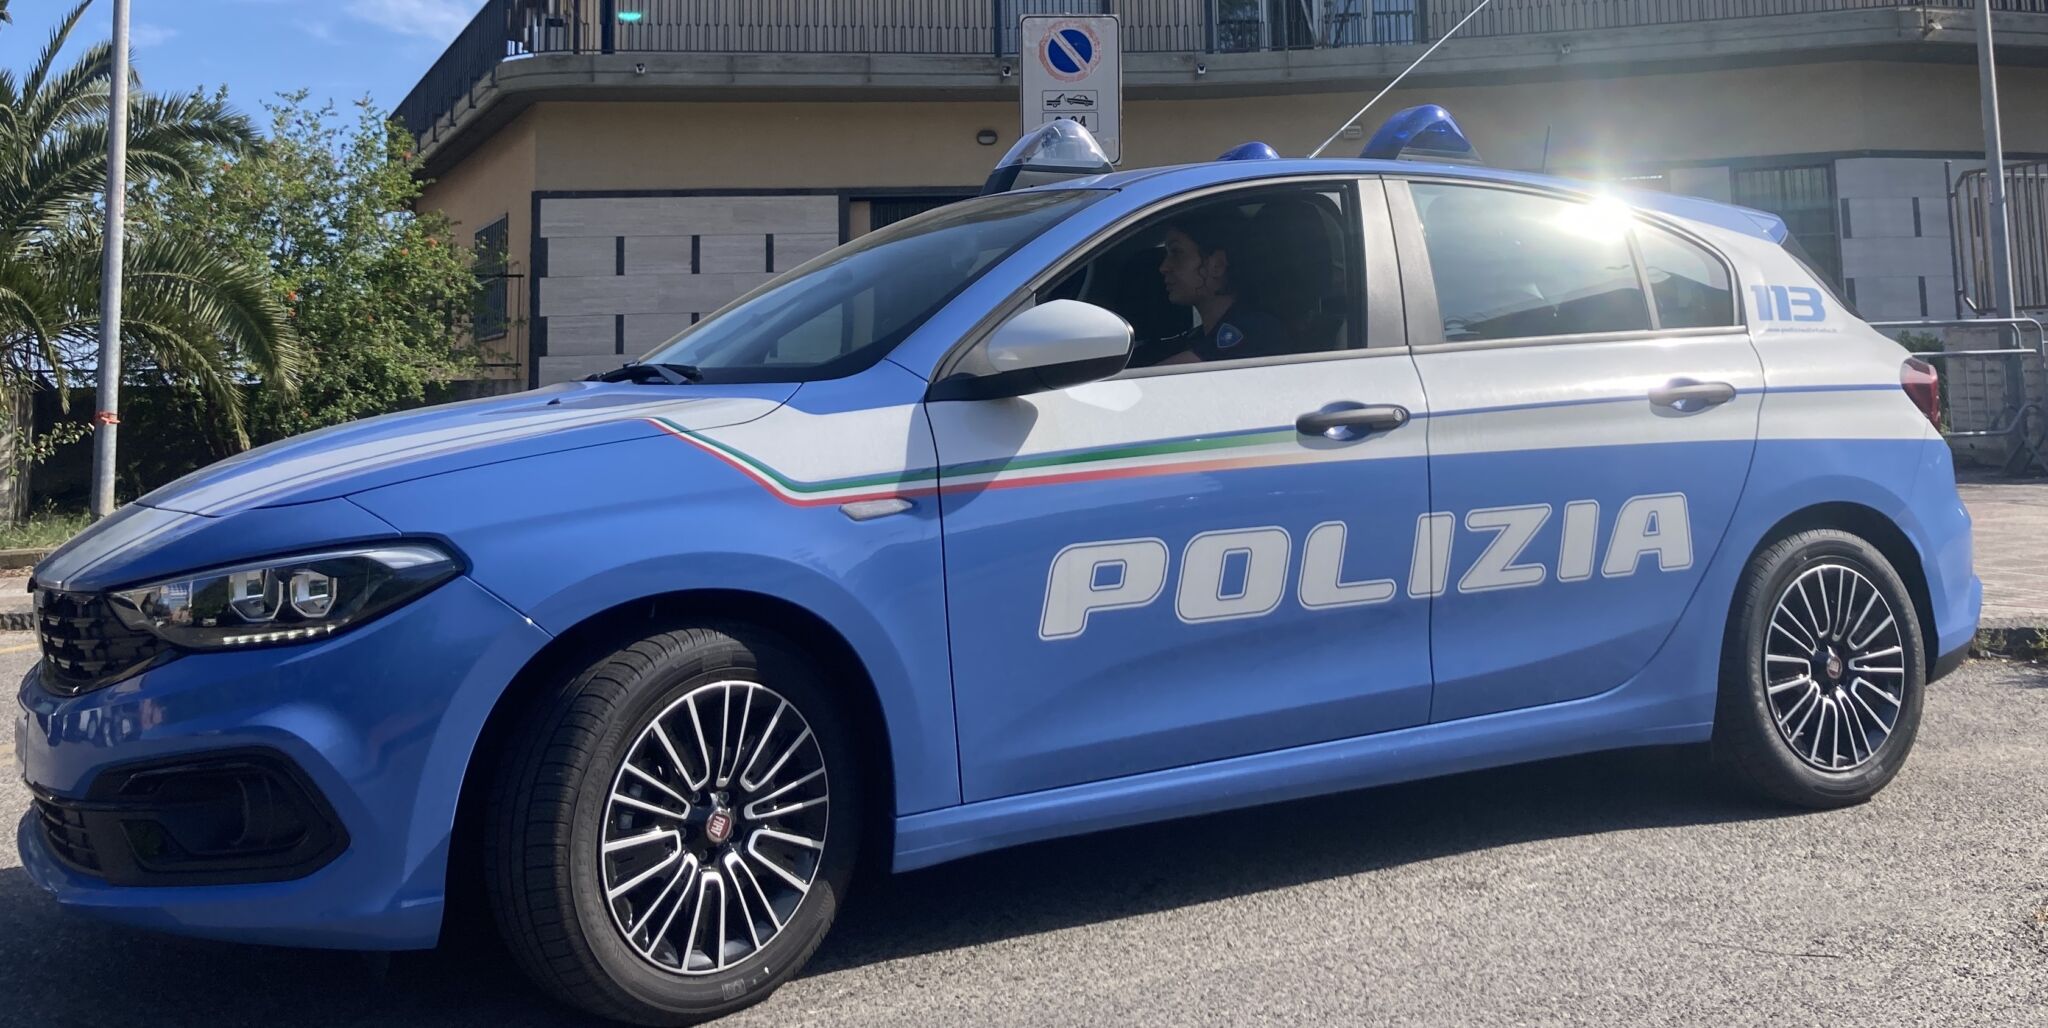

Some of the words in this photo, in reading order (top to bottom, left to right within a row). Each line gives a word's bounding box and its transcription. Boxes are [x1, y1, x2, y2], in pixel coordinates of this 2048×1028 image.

[1750, 285, 1826, 322] 113
[1038, 492, 1693, 640] POLIZIA
[710, 815, 726, 837] FIAT
